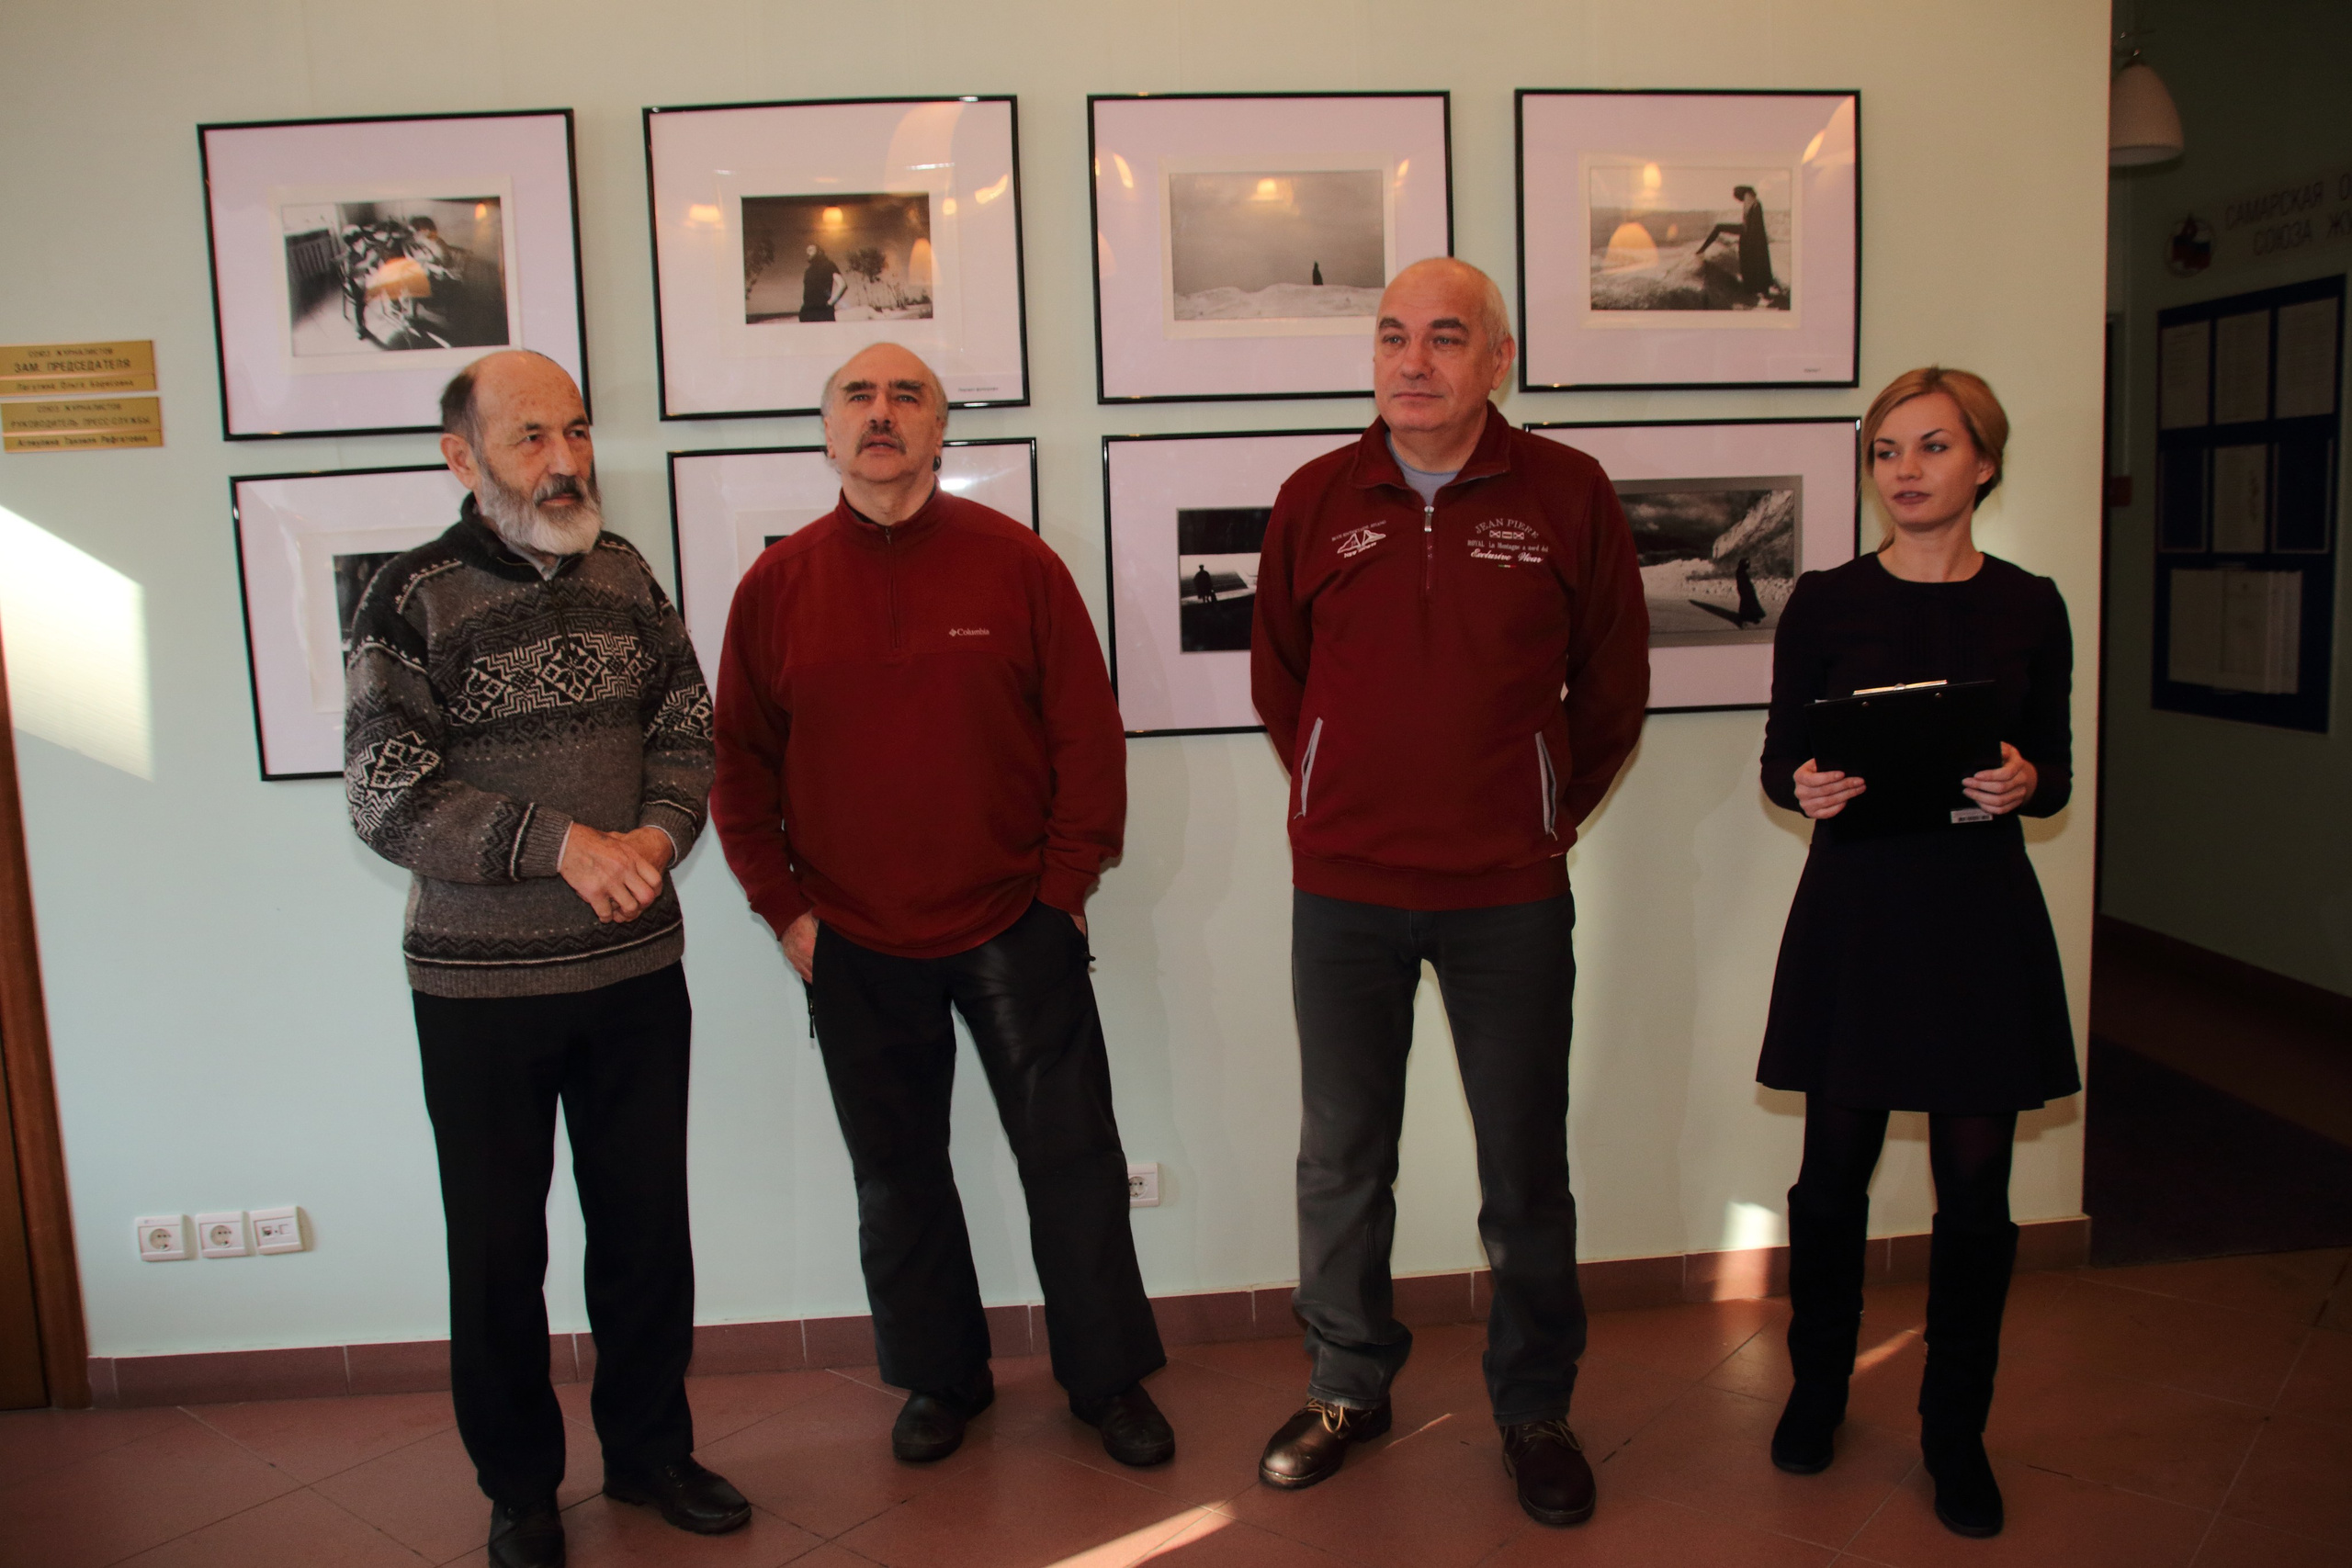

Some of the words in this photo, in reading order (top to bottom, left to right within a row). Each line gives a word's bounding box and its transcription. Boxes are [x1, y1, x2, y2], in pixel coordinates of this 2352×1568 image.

[2224, 180, 2324, 231] САМАРСКАЯ
[2253, 219, 2313, 256] СОЮЗА
[47, 358, 131, 373] ПРЕДСЕДАТЕЛЯ
[1475, 517, 1504, 535] JEAN
[1470, 547, 1513, 561] Exclusive
[1518, 551, 1544, 563] Wear
[956, 627, 990, 636] Columbia
